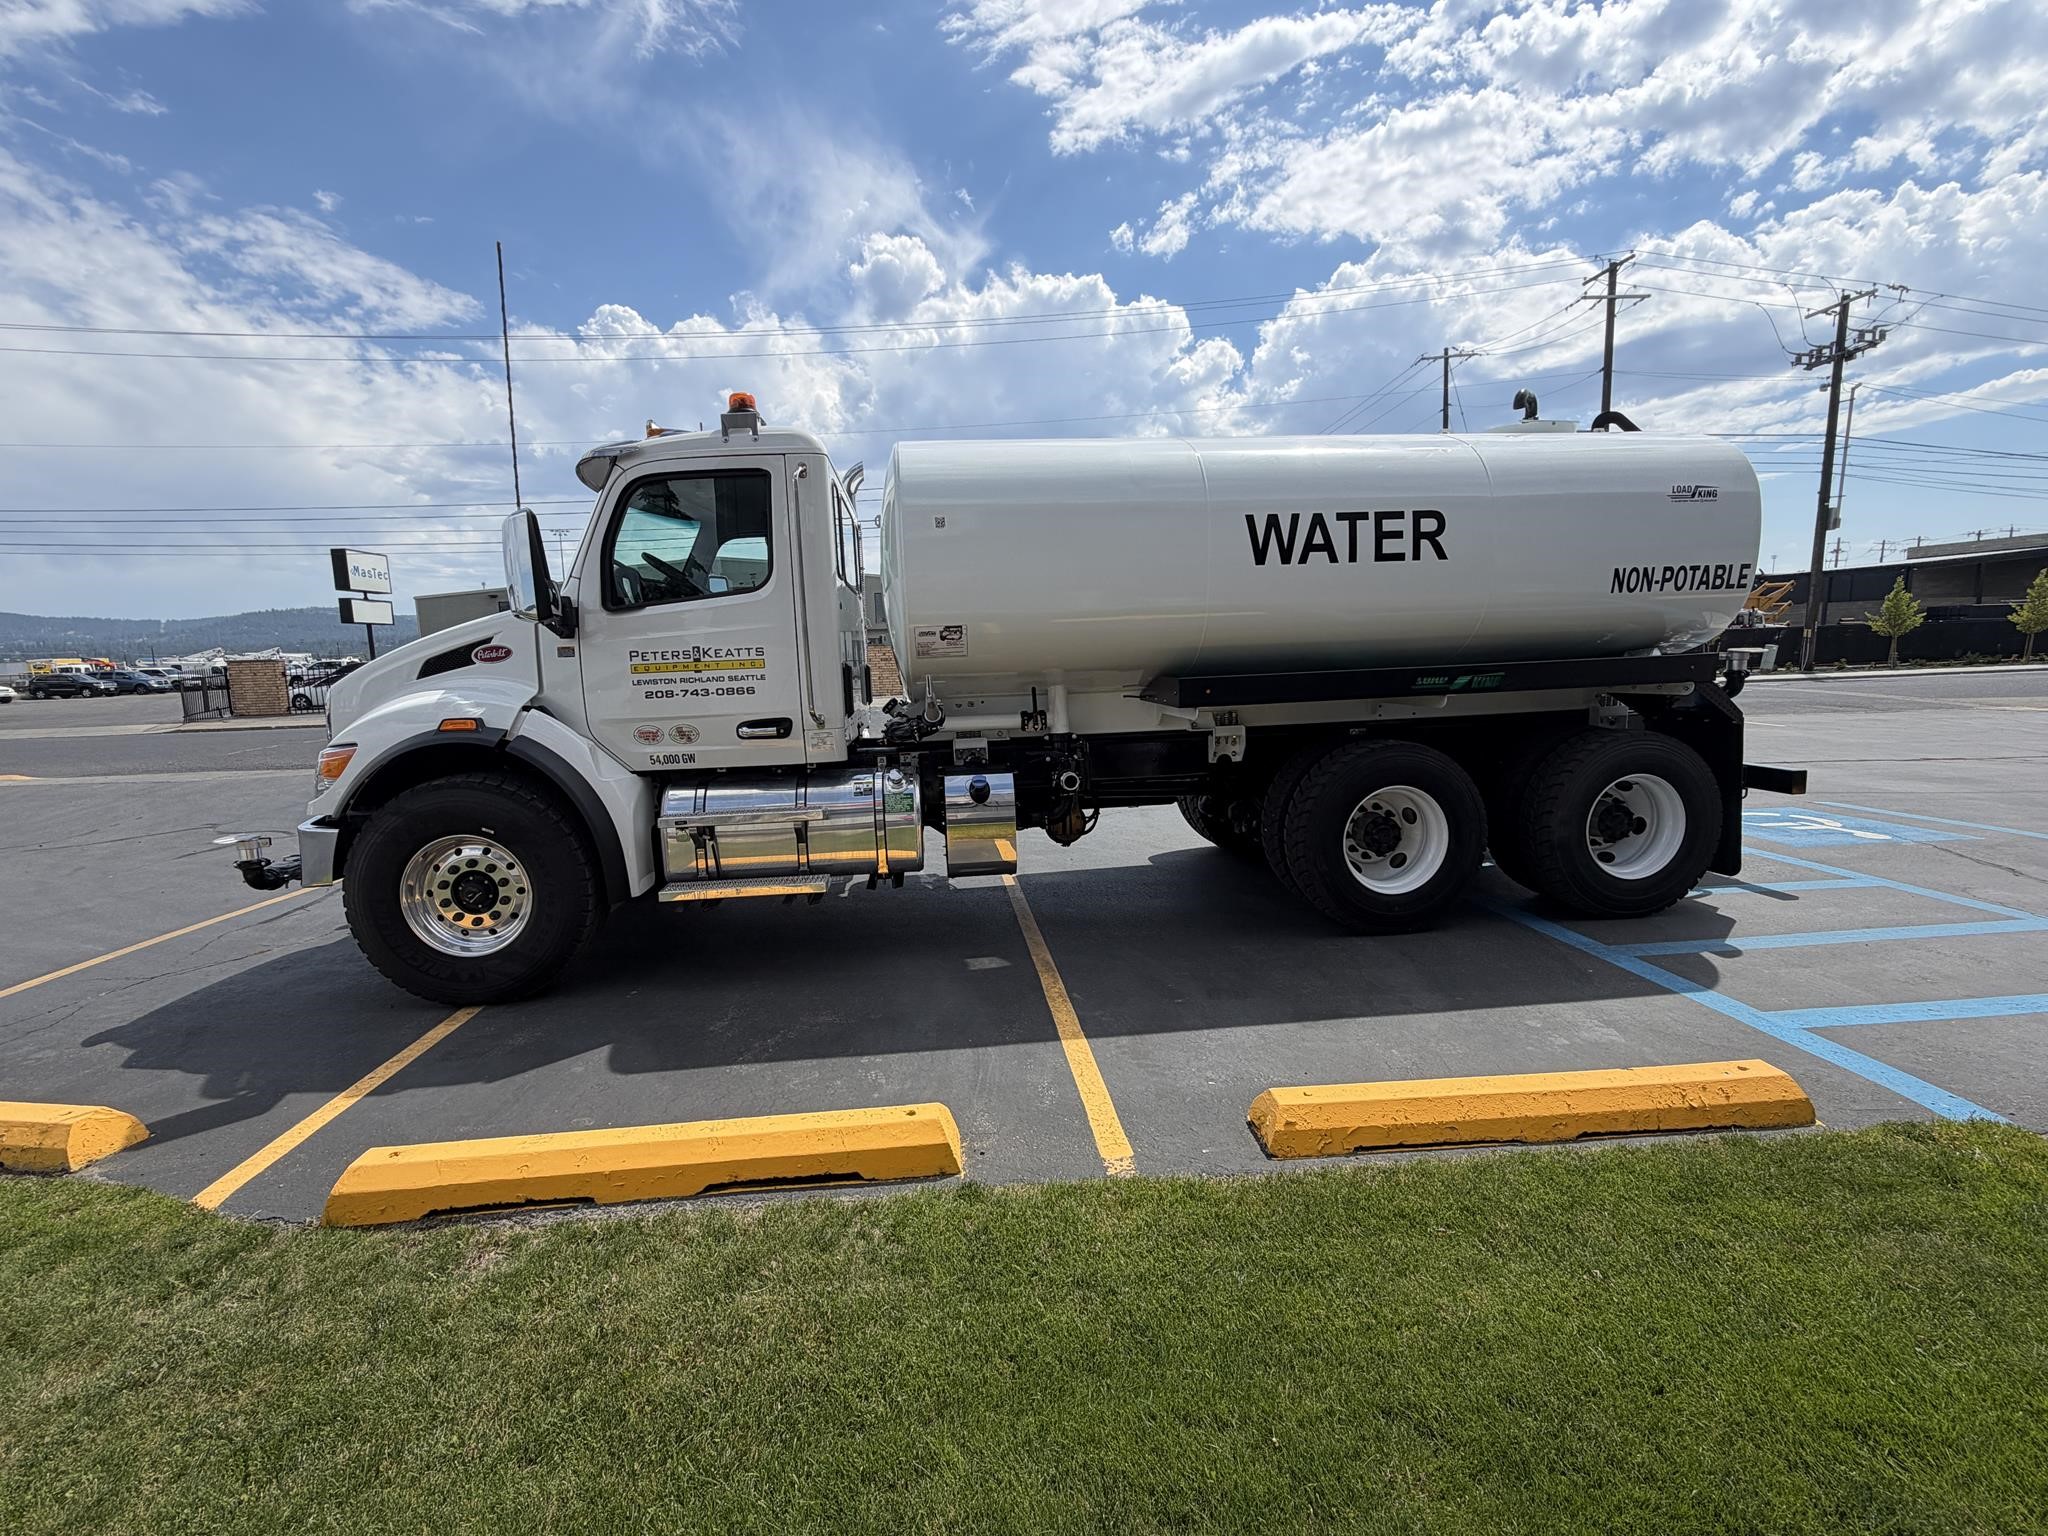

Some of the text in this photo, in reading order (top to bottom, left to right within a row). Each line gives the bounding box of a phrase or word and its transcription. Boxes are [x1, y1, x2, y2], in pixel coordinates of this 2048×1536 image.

[1672, 485, 1718, 498] LOAD KING
[1245, 509, 1449, 566] WATER
[352, 565, 389, 580] MasTec
[1610, 563, 1752, 594] NON-POTABLE
[629, 650, 691, 662] PETERS
[702, 647, 765, 659] KEATTS
[633, 662, 720, 672] EQUIPMENT
[632, 674, 766, 686] LEWISTON RICHLAND SEATTLE
[644, 686, 756, 699] 208-743-0866
[649, 753, 696, 766] 54,000 GW
